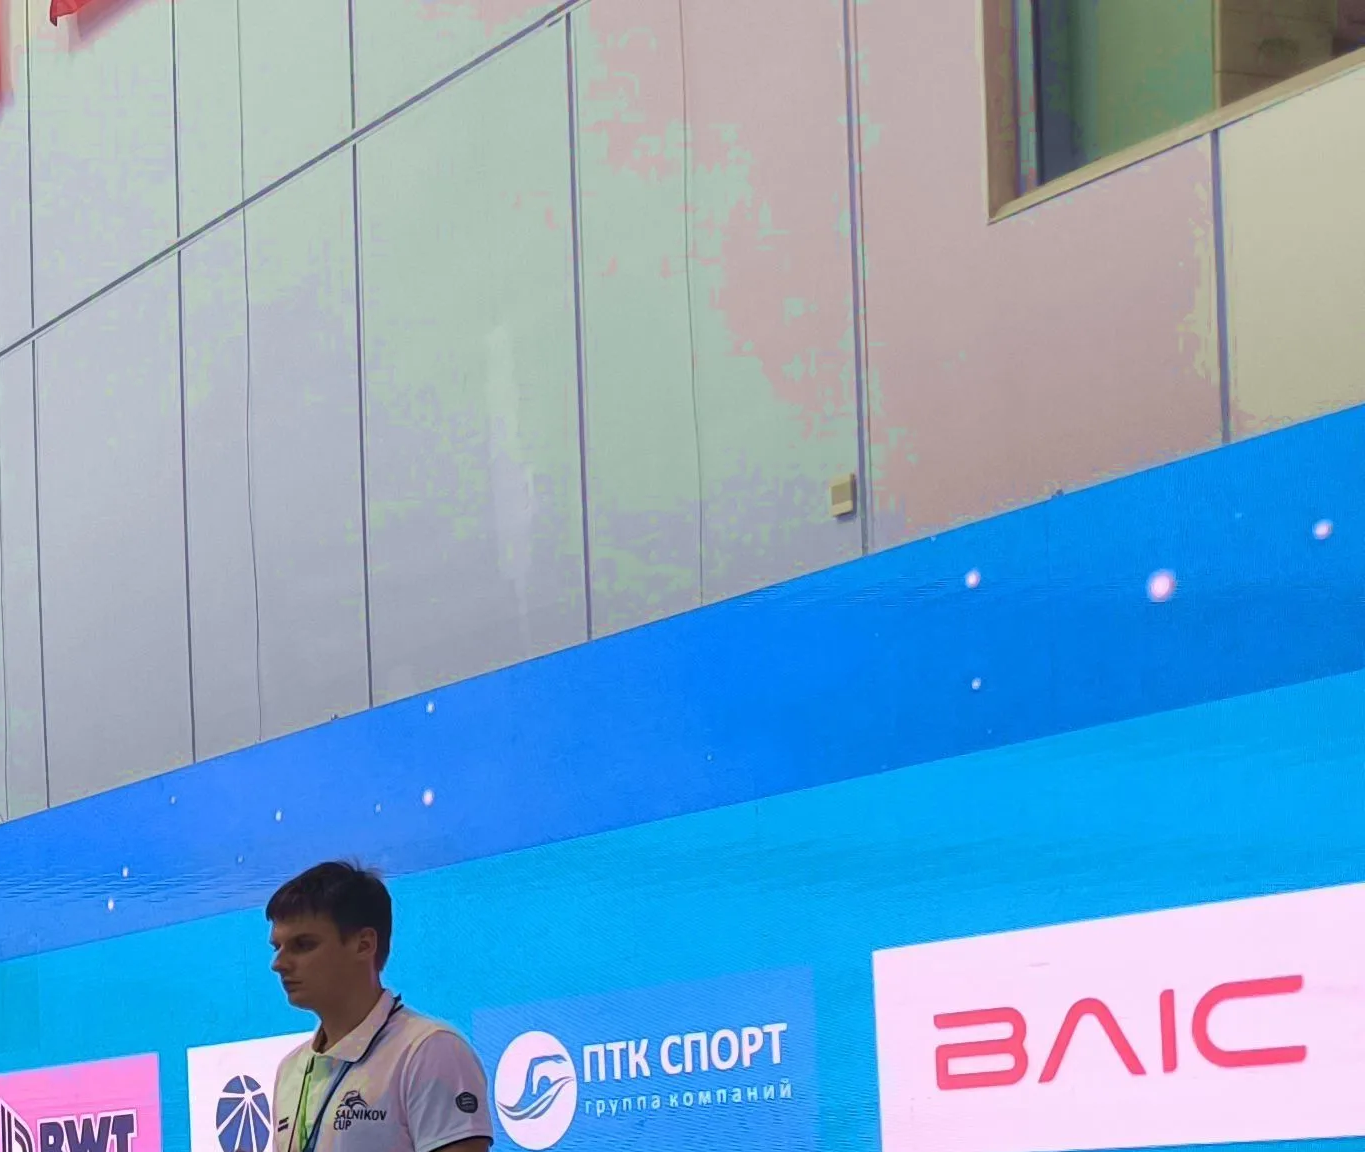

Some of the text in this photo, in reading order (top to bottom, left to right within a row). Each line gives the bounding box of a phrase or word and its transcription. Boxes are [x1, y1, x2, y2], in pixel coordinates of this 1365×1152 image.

[583, 1022, 787, 1082] ПТК СПОРТ
[932, 974, 1308, 1091] BAIC
[335, 1109, 387, 1121] SALNIKOV
[585, 1078, 793, 1117] группа компаний
[333, 1120, 352, 1131] CUP
